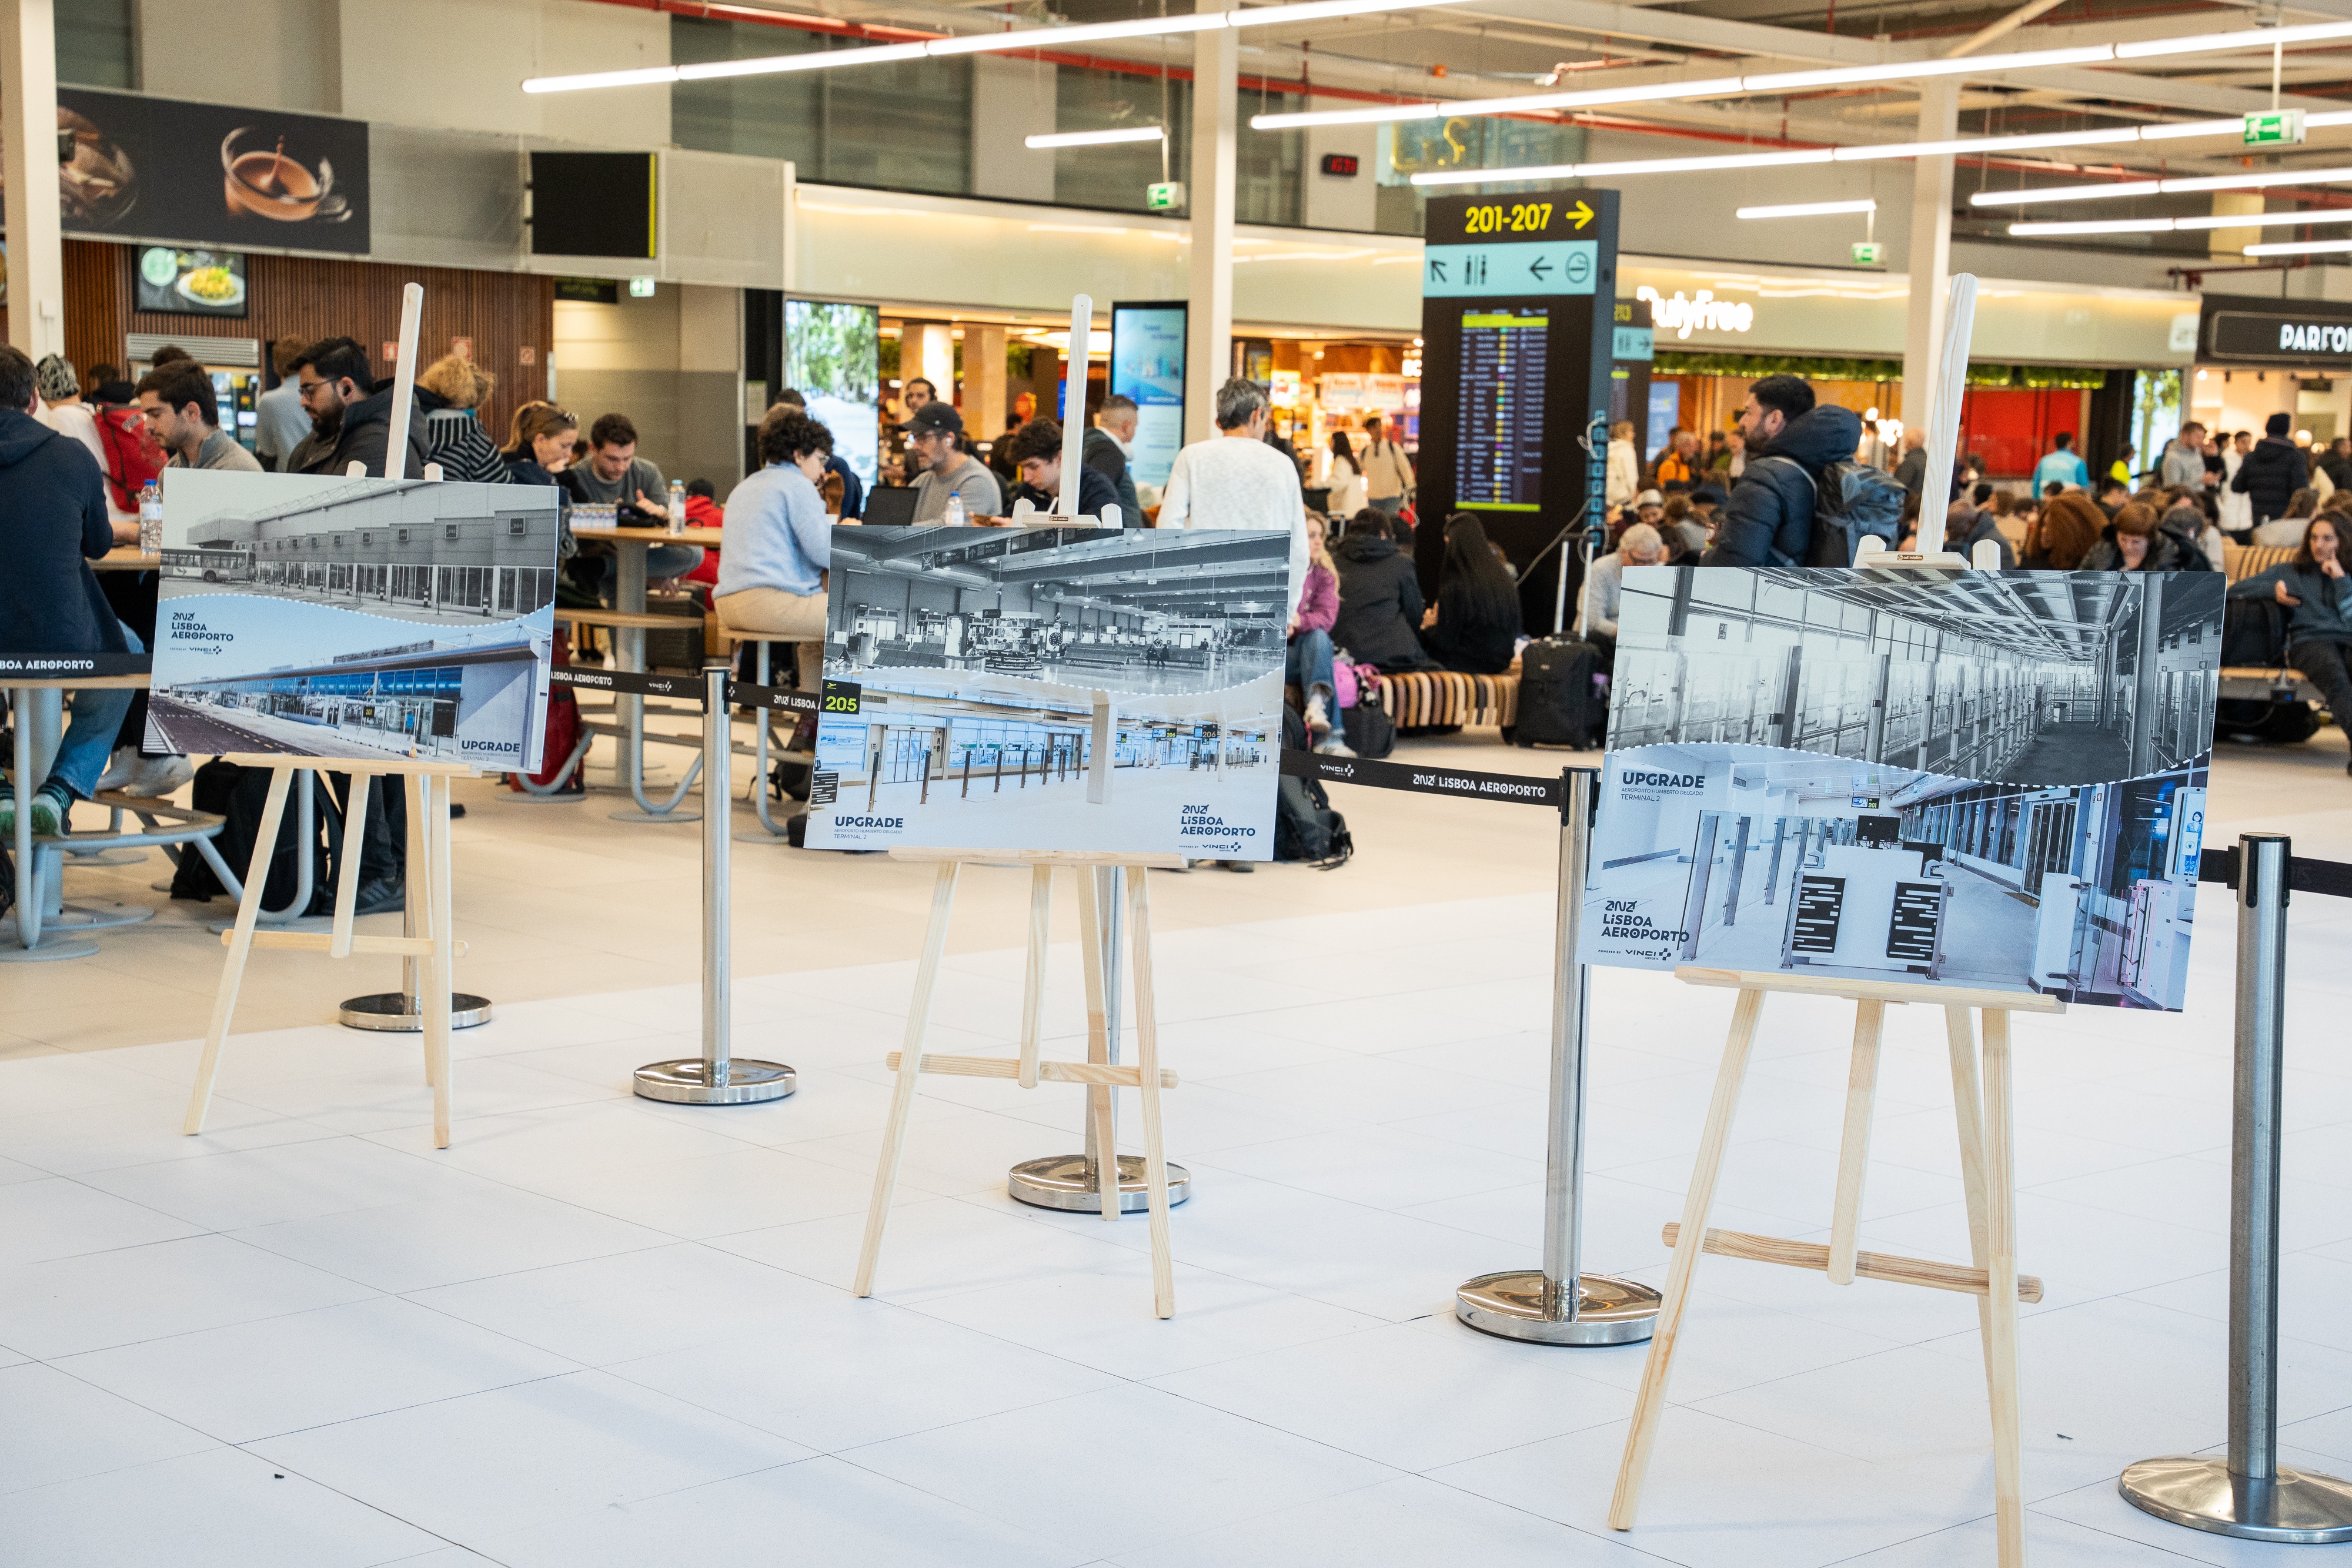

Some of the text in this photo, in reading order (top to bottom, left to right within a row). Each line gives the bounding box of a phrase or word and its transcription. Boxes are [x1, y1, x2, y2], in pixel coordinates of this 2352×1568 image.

[1465, 203, 1552, 233] 201-207
[171, 631, 233, 641] AEROPORTO
[0, 660, 94, 670] BOA AEROPORTO
[573, 673, 613, 686] AEROPORTO
[826, 696, 857, 712] 205
[462, 740, 520, 752] UPGRADE
[1320, 764, 1343, 773] VINCI
[1622, 772, 1705, 788] UPGRADE
[1479, 781, 1546, 797] AEROPORTO
[835, 816, 903, 828] UPGRADE
[1180, 826, 1255, 836] AEROPORTO
[1601, 926, 1690, 942] AEROPORTO
